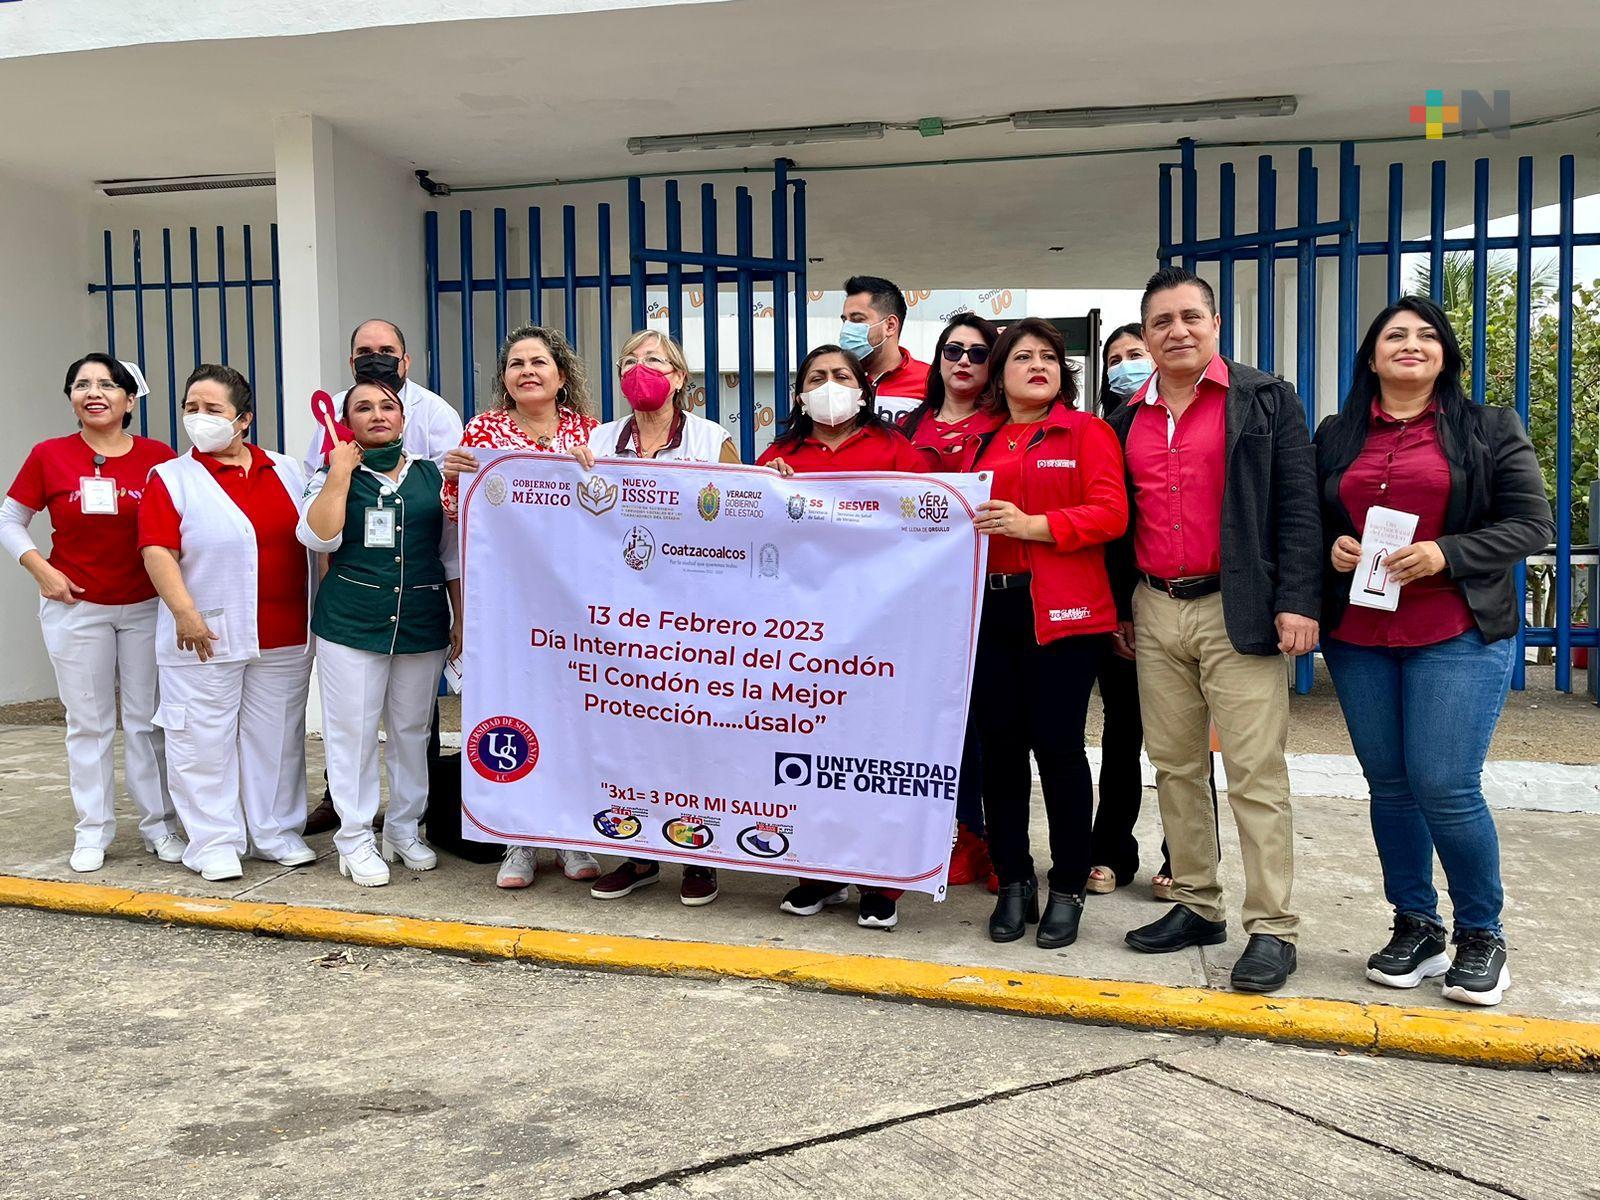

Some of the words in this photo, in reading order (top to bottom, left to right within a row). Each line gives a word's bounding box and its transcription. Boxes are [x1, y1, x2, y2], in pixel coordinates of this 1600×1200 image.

[991, 289, 1012, 315] UO
[940, 304, 968, 322] Somos
[512, 479, 557, 490] GOBIERNO
[559, 481, 571, 490] DE
[622, 478, 657, 488] NUEVO
[512, 489, 571, 506] MÉXICO
[622, 489, 680, 505] ISSSTE
[726, 490, 762, 500] VERACRUZ
[809, 499, 823, 508] SS
[918, 491, 948, 507] VERA
[725, 499, 759, 509] GOBIERNO
[838, 500, 879, 511] SESVER
[724, 508, 737, 517] DEL
[738, 509, 764, 519] ESTADO
[918, 506, 948, 523] CRUZ
[661, 543, 746, 560] Coatzacoalcos
[587, 605, 611, 625] 13
[619, 608, 651, 628] de
[659, 611, 757, 636] Febrero
[763, 619, 824, 642] 2023
[531, 628, 566, 650] Día
[574, 633, 735, 665] Internacional
[743, 649, 781, 669] del
[789, 652, 894, 677] Condón
[604, 667, 699, 694] Condón
[707, 682, 734, 697] es
[742, 679, 762, 700] la
[772, 682, 847, 709] Mejor
[469, 718, 501, 763] UNIVERSIDAD
[502, 717, 513, 726] DE
[816, 755, 957, 781] UNIVERSIDAD
[816, 771, 846, 791] DE
[853, 774, 957, 800] ORIENTE
[650, 790, 660, 804] 3
[664, 792, 699, 809] POR
[704, 796, 726, 813] MI
